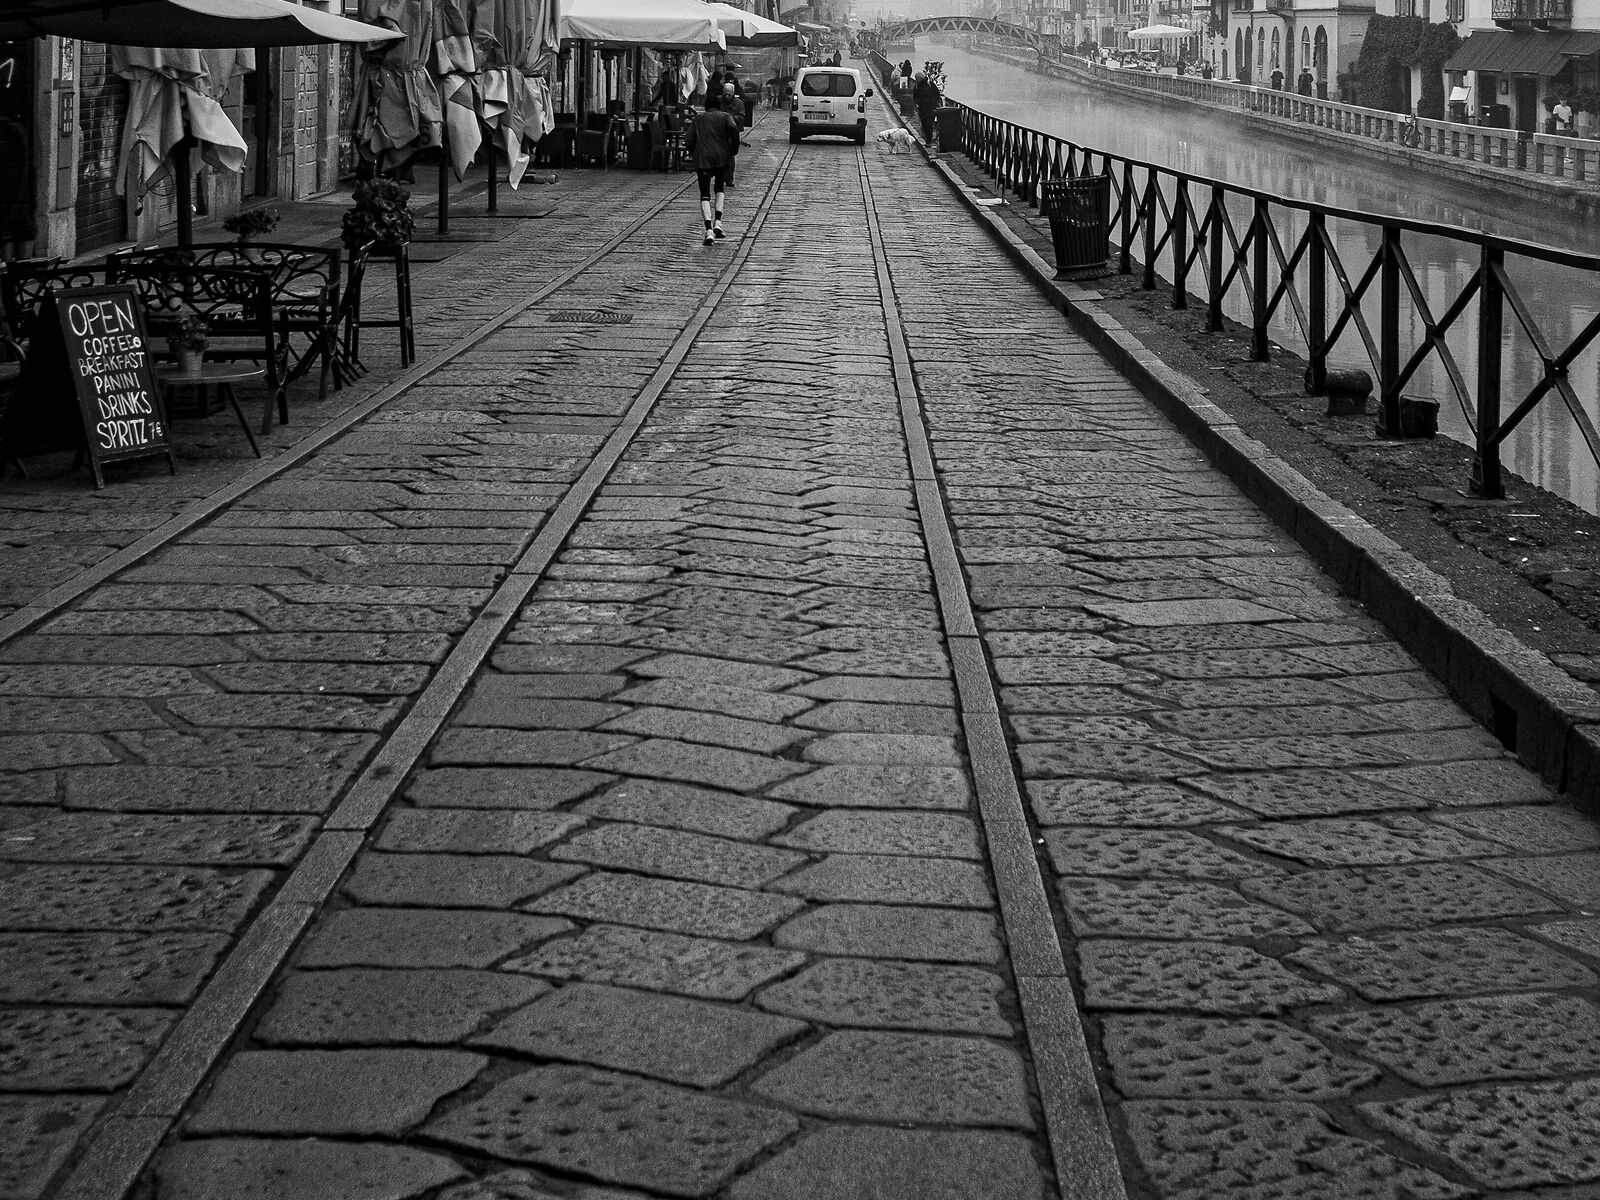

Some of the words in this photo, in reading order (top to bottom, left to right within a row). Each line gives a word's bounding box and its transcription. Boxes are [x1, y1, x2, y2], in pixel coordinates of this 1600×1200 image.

[68, 299, 135, 336] OPEN
[83, 334, 135, 356] COFFEE
[78, 352, 145, 376] BREAKFAST
[93, 372, 141, 394] PANINI
[97, 391, 152, 419] DRINKS
[96, 418, 148, 449] SPRITZ
